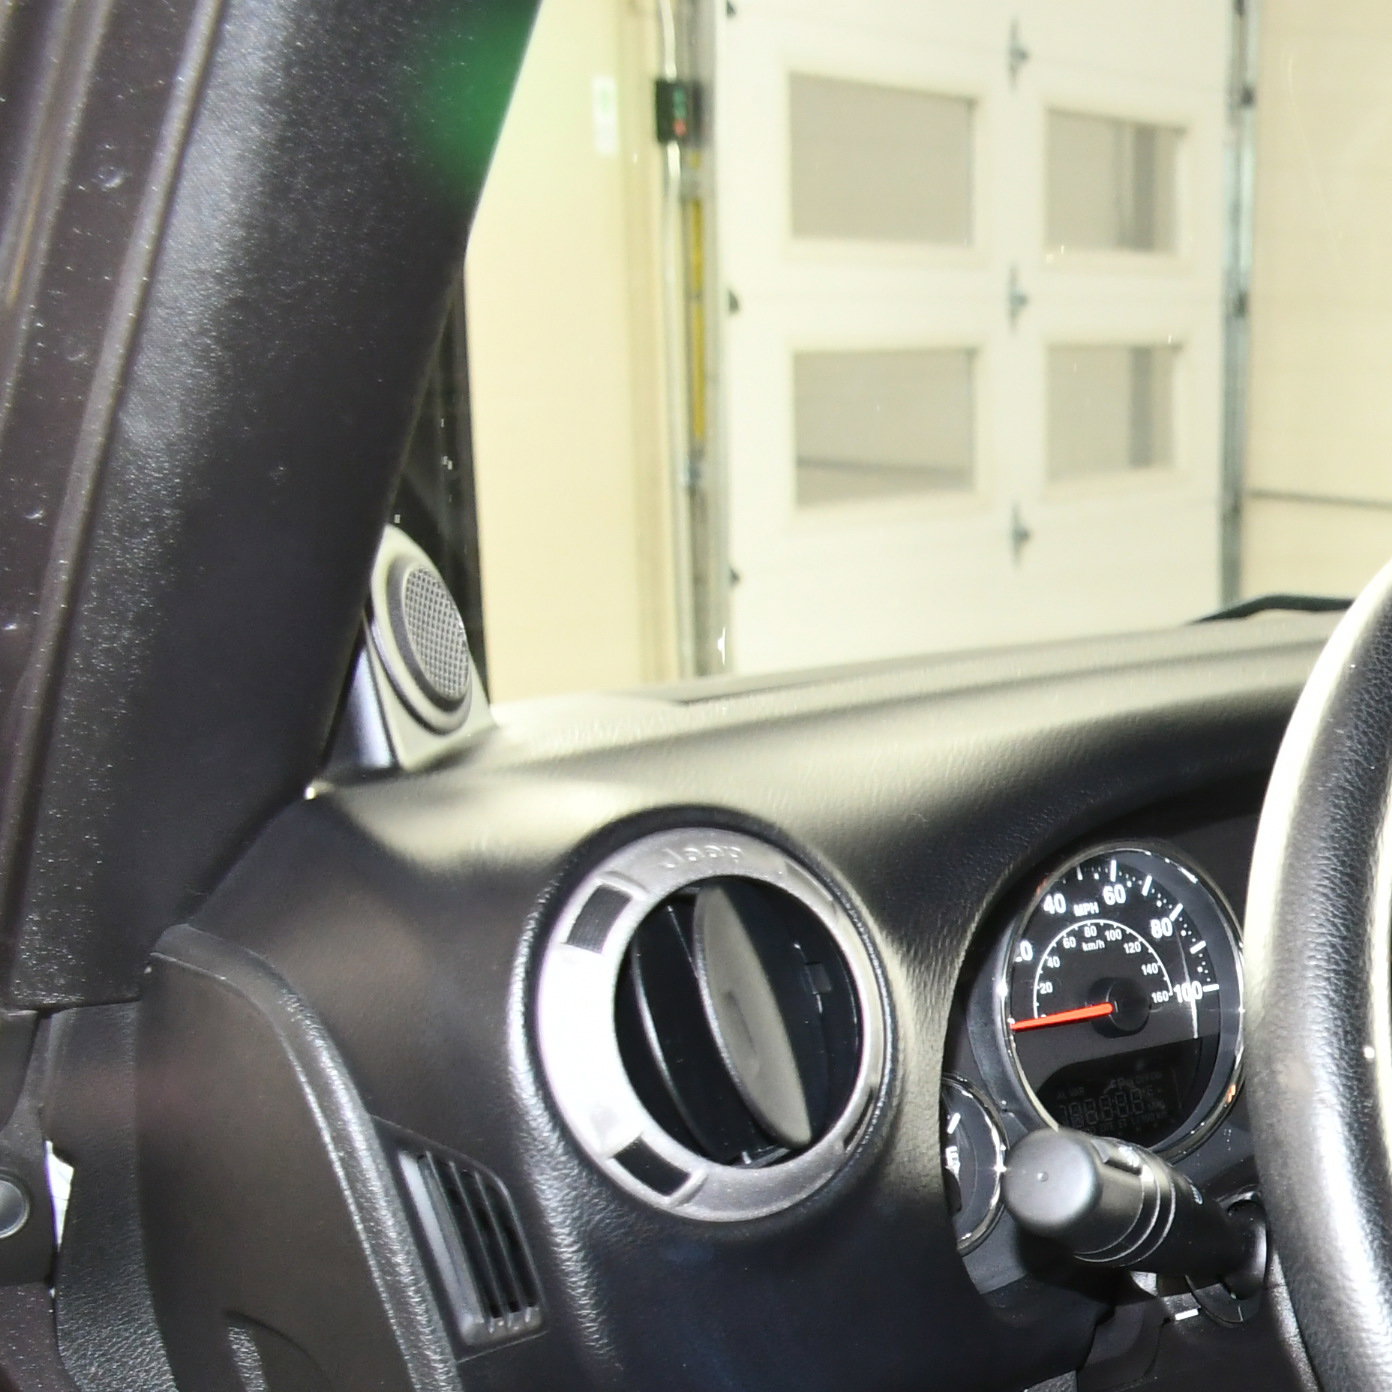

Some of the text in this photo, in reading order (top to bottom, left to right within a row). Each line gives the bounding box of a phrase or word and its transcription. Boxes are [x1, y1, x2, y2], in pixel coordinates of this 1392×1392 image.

[1103, 884, 1126, 906] 60
[1043, 893, 1066, 915] 40
[1073, 902, 1099, 917] MPH
[1084, 926, 1097, 938] 80
[1150, 917, 1173, 939] 80
[1062, 936, 1076, 949] 60
[1105, 929, 1122, 942] 100
[1014, 940, 1033, 962] 0
[1082, 940, 1105, 952] km/h
[1124, 941, 1141, 955] 120
[1046, 956, 1060, 968] 40
[1141, 962, 1159, 976] 140
[1040, 981, 1053, 994] 20
[1173, 980, 1203, 1003] 100
